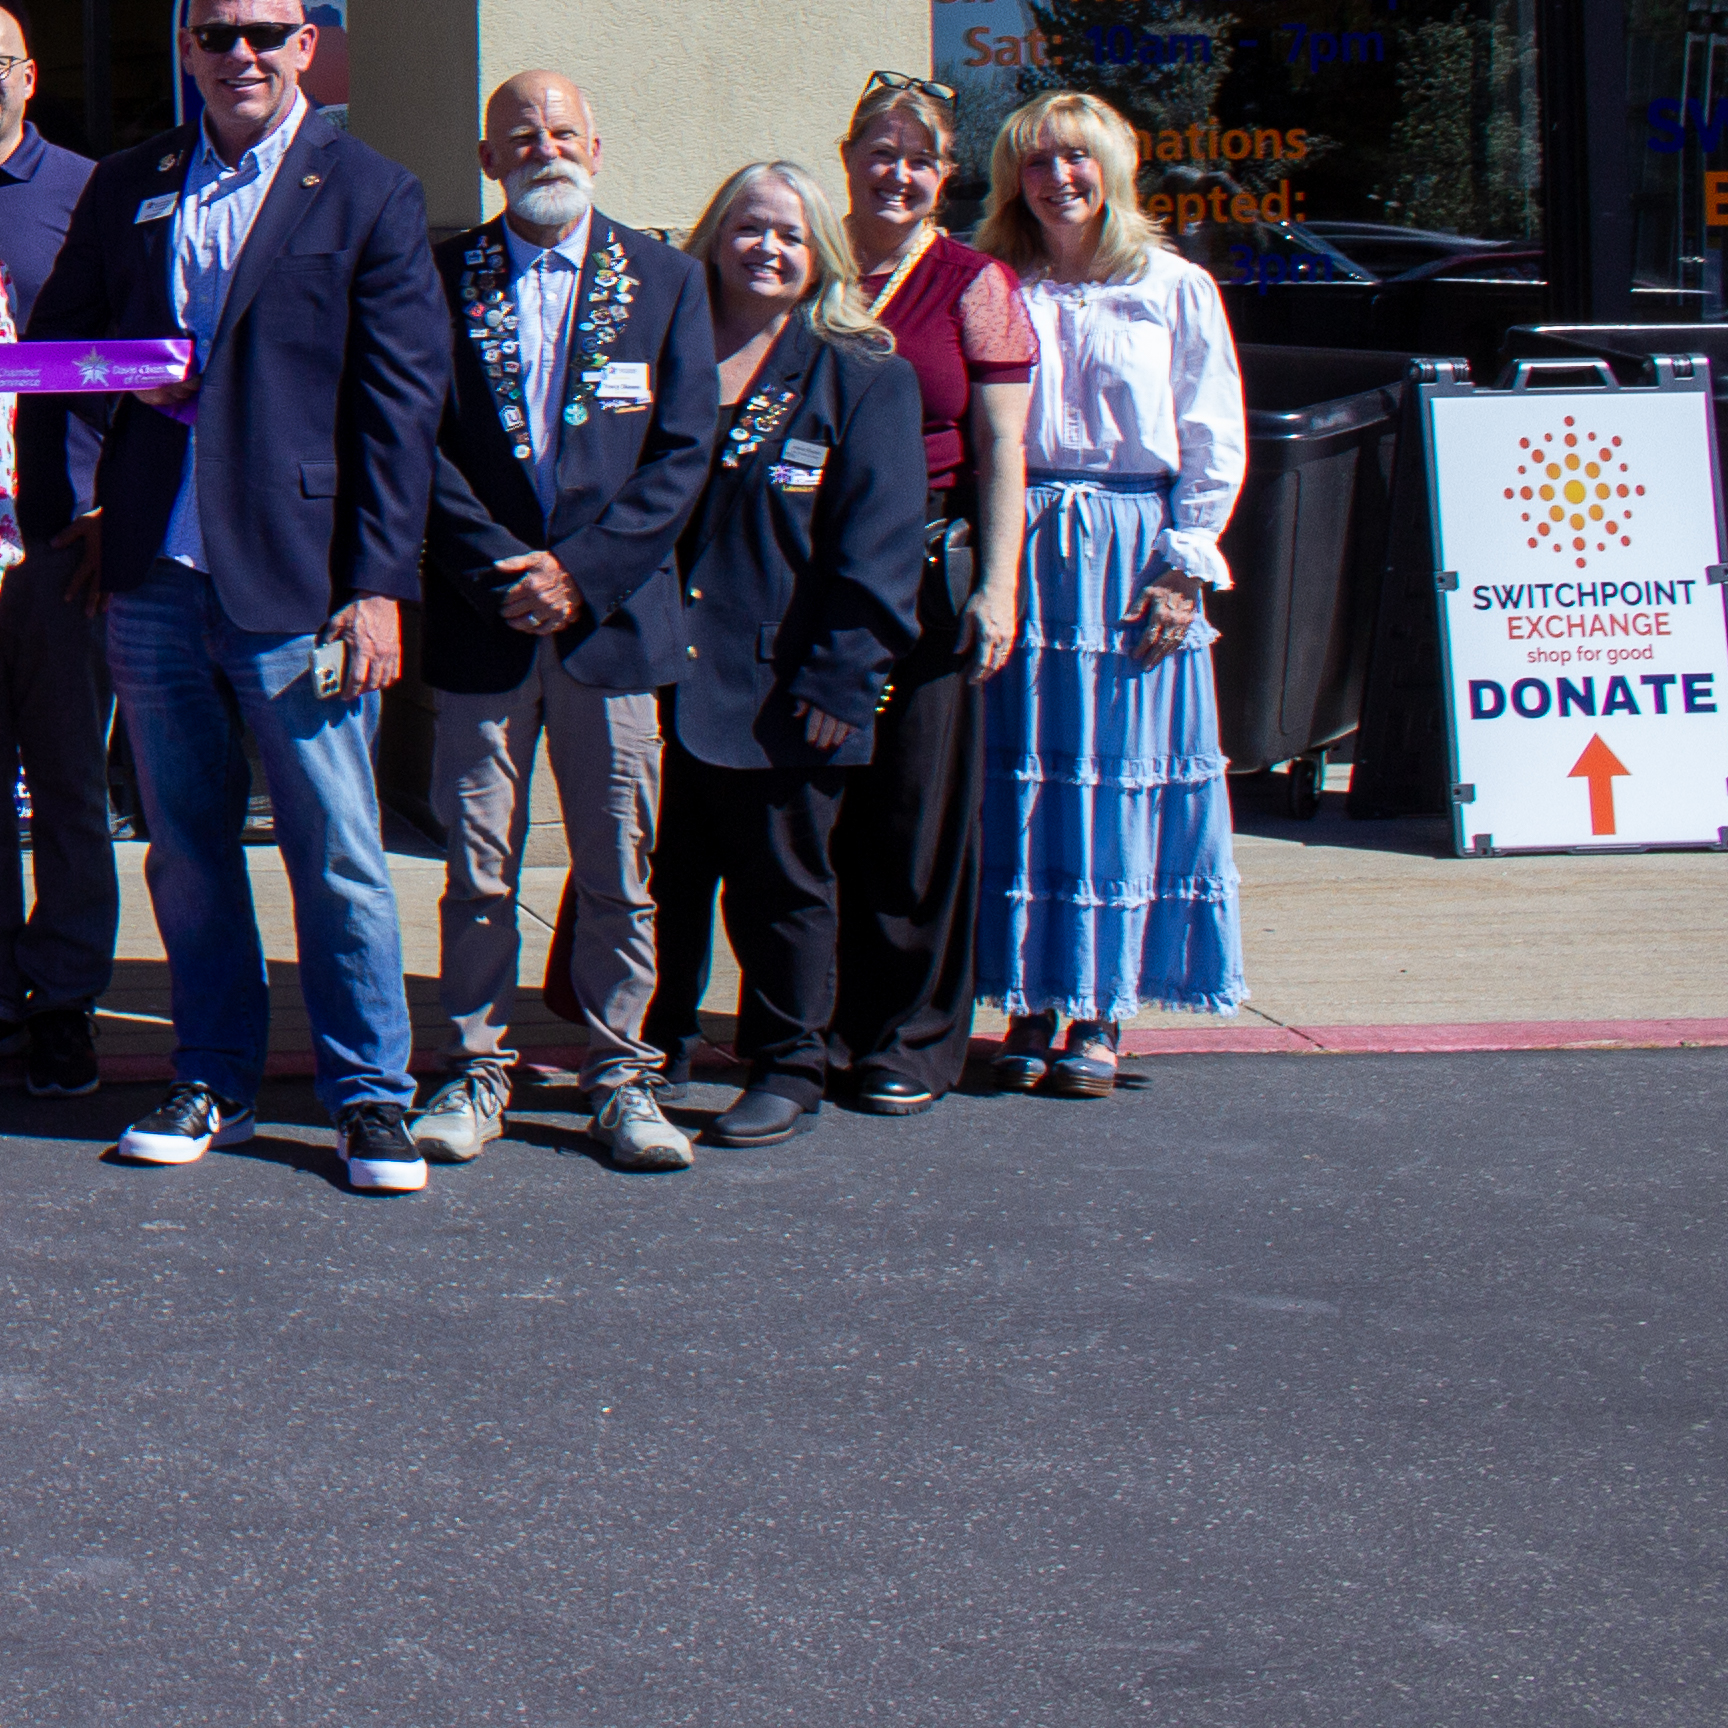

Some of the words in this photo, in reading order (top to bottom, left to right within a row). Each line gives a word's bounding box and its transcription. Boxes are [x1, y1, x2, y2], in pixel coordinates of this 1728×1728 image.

[962, 26, 1063, 67] Sat:
[1085, 24, 1213, 65] 10am
[1280, 23, 1385, 72] 7pm
[1136, 119, 1309, 161] nations
[1144, 178, 1308, 236] epted:
[1230, 244, 1334, 296] 3pm
[1472, 579, 1696, 610] SWITCHPOINT
[1507, 612, 1672, 640] EXCHANGE
[1527, 645, 1572, 665] shop
[1576, 645, 1602, 662] for
[1606, 644, 1654, 665] good
[1467, 672, 1718, 720] DONATE
